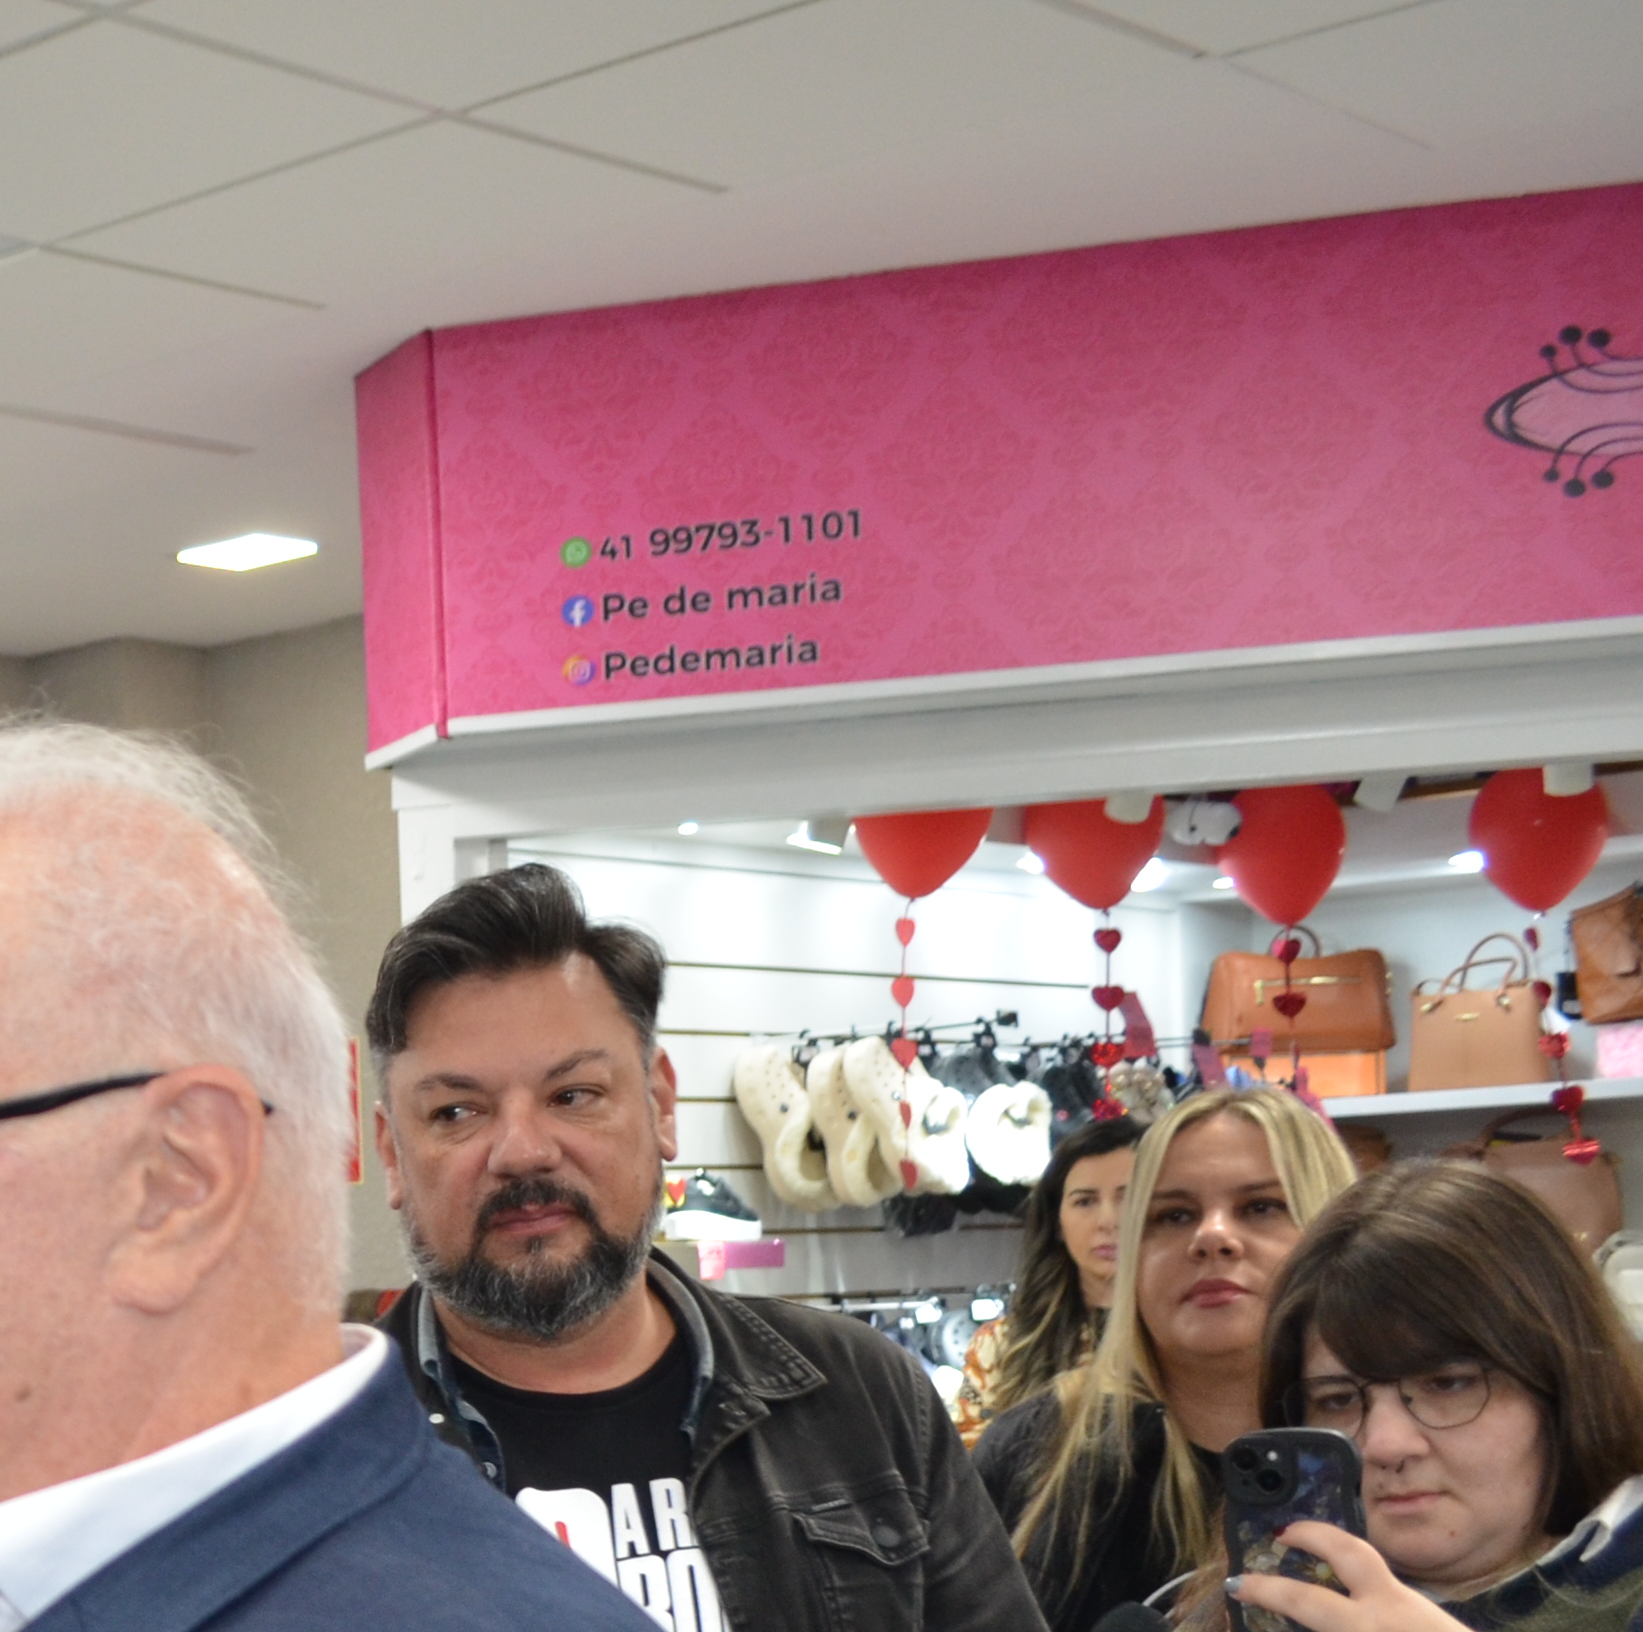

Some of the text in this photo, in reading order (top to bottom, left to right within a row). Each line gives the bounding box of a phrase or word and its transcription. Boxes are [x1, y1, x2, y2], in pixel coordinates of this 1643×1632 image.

[599, 509, 862, 560] 41 99793-1101
[601, 573, 842, 621] Pe de maria
[604, 634, 819, 680] Pedemaria
